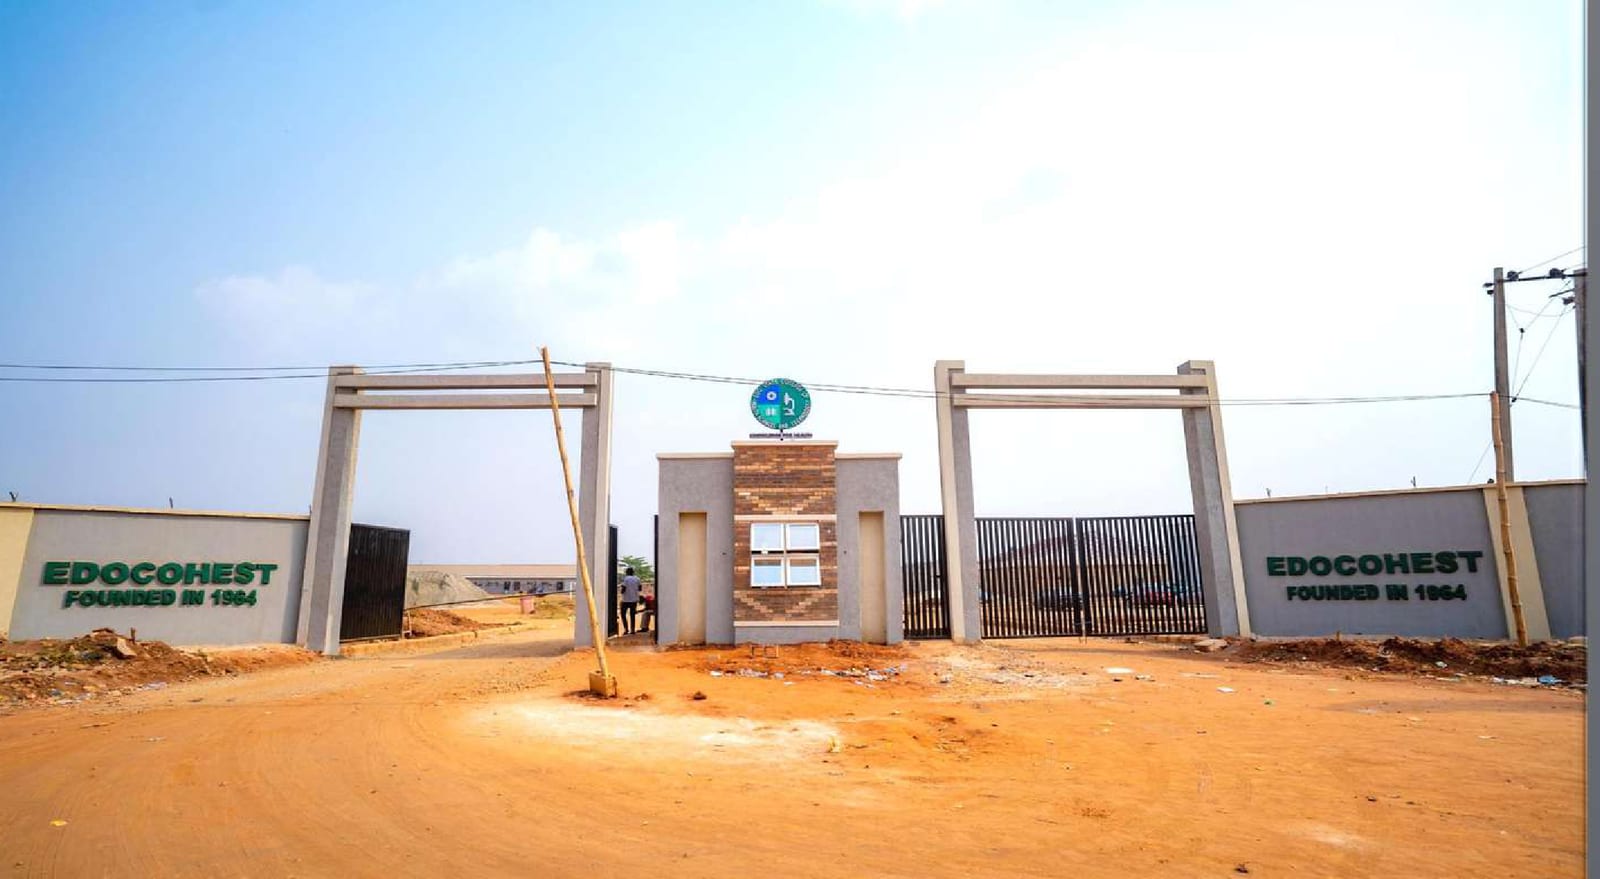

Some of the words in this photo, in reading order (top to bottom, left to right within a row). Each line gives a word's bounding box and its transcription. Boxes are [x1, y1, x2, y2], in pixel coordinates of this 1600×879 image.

[42, 560, 278, 586] EDOCOHEST
[1266, 550, 1484, 577] EDOCOHEST
[63, 589, 177, 608] FOUNDED
[181, 589, 205, 606] IN
[210, 589, 258, 606] 1964
[1287, 584, 1380, 602] FOUNDED
[1386, 583, 1409, 601] IN
[1414, 583, 1468, 601] 1964
